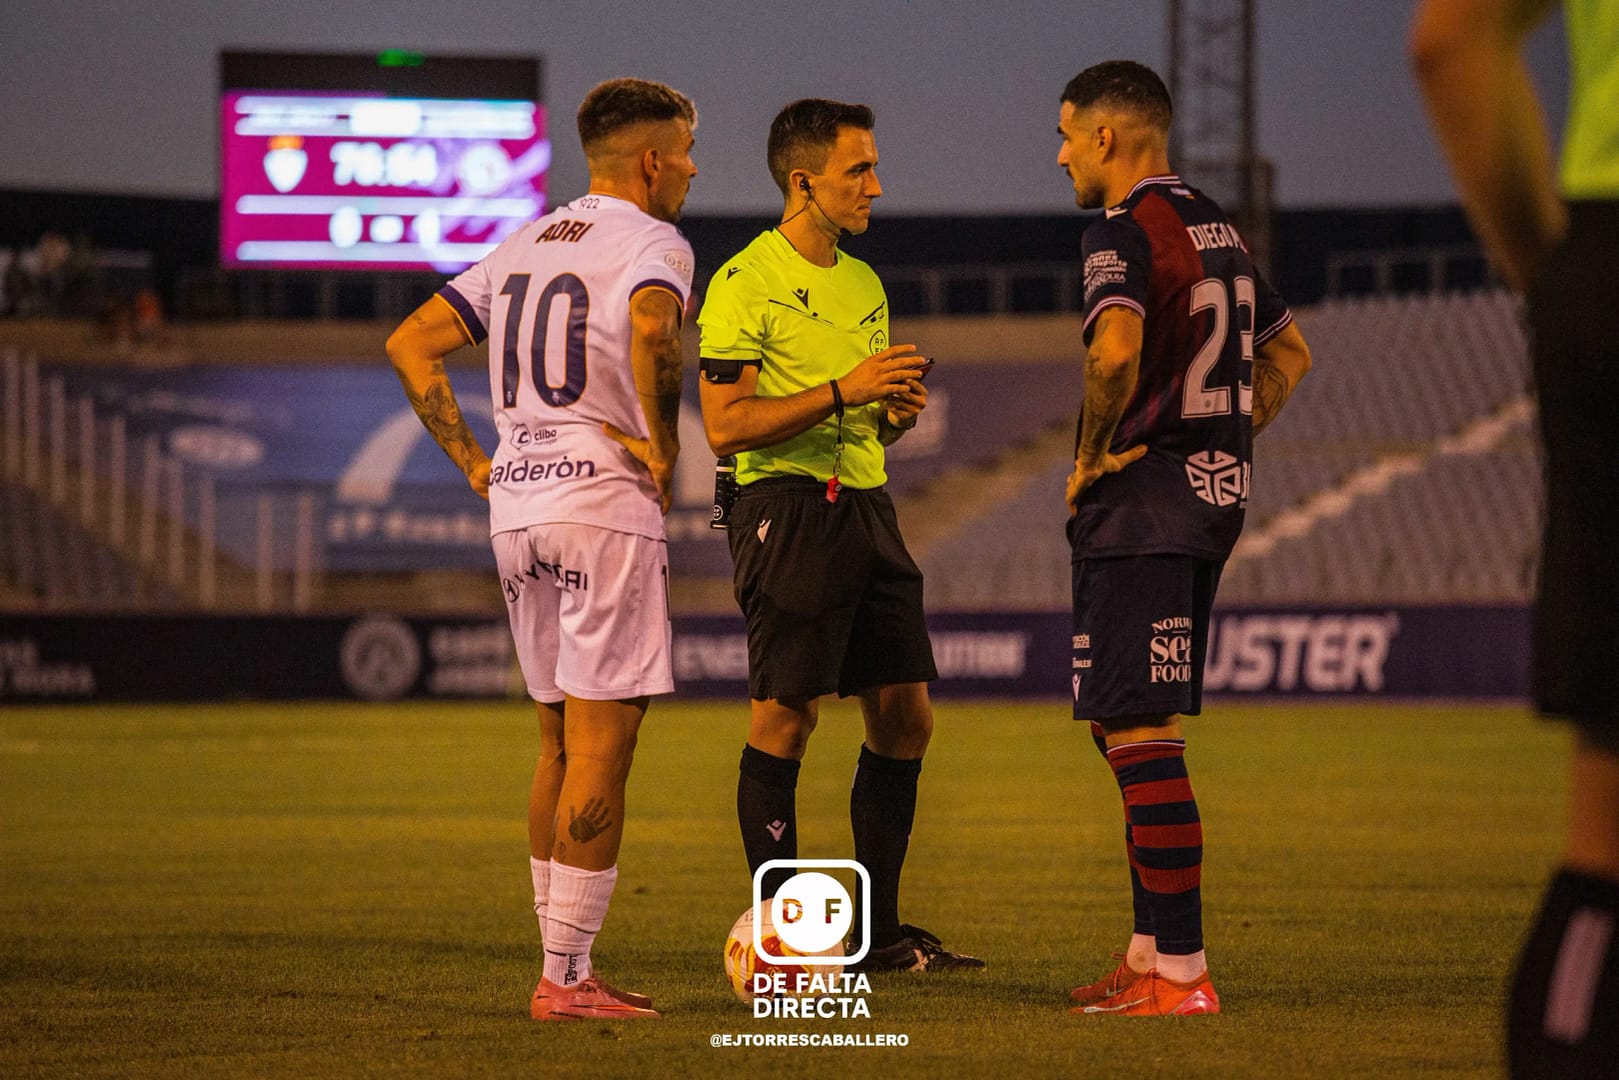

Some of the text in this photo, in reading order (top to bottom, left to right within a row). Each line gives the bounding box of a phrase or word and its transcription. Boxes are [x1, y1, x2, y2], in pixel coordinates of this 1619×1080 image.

[535, 219, 595, 244] ADRI
[499, 272, 590, 409] 10
[1180, 275, 1255, 419] 23
[534, 428, 557, 441] clibo
